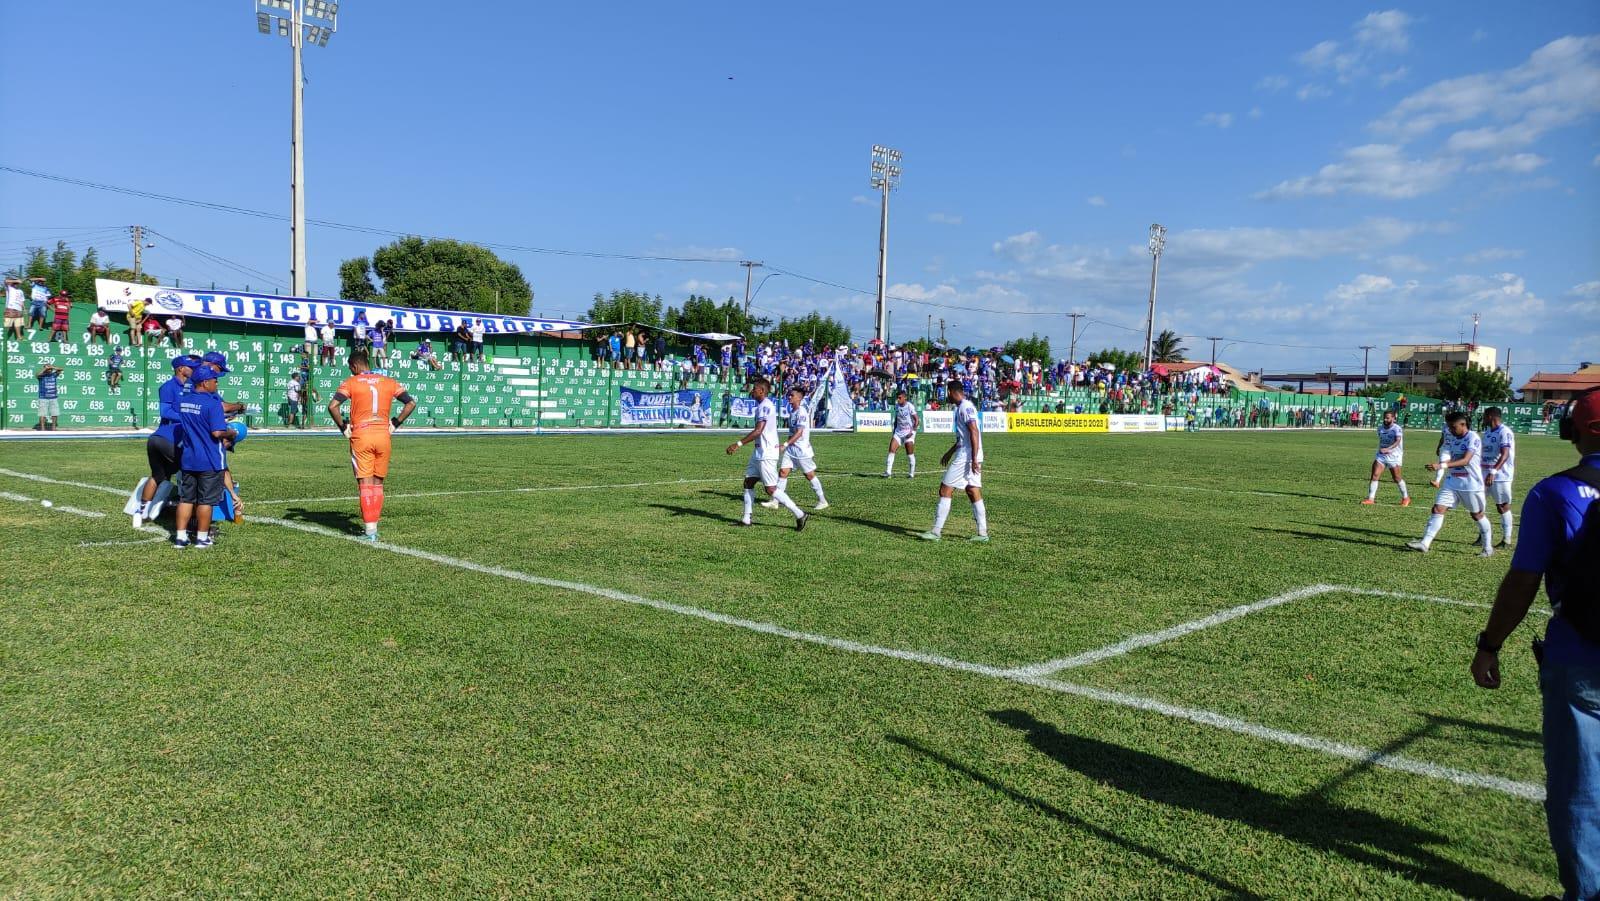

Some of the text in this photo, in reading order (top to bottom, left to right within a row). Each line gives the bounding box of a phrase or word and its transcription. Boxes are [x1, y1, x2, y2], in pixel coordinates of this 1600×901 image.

[195, 295, 369, 326] TORCIDA
[27, 329, 36, 340] 7
[83, 332, 91, 343] 9
[183, 338, 193, 348] 13
[206, 339, 217, 349] 14
[228, 340, 239, 350] 15
[252, 342, 262, 352] 16
[273, 342, 282, 352] 17
[334, 347, 345, 355] 20
[391, 350, 401, 359] 23
[31, 342, 50, 353] 133
[59, 343, 78, 354] 134
[86, 344, 104, 356] 135
[236, 352, 250, 362] 141
[280, 354, 295, 364] 143
[399, 360, 411, 369] 149
[484, 364, 495, 372] 154
[7, 355, 25, 364] 258
[38, 356, 55, 365] 259
[66, 357, 83, 366] 260
[94, 359, 108, 367] 261
[147, 361, 161, 369] 263
[243, 365, 257, 373] 267
[389, 370, 401, 378] 274
[426, 372, 436, 380] 276
[15, 369, 33, 379] 384
[73, 371, 91, 380] 386
[128, 372, 144, 382] 388
[228, 376, 243, 386] 392
[251, 377, 265, 386] 393
[274, 378, 287, 387] 394
[319, 380, 331, 388] 396
[416, 383, 426, 391] 401
[24, 385, 38, 393] 510
[82, 386, 96, 395] 512
[237, 390, 249, 399] 518
[370, 386, 378, 415] 1
[640, 393, 680, 405] PODER
[63, 400, 78, 409] 637
[90, 401, 104, 410] 638
[117, 401, 130, 410] 639
[268, 404, 280, 412] 645
[1374, 402, 1388, 410] EU
[1409, 402, 1436, 412] PHB
[1515, 406, 1532, 415] FAZ
[9, 414, 24, 423] 761
[71, 415, 86, 423] 763
[98, 415, 113, 423] 764
[1016, 417, 1062, 427] BRASILEIRÃO
[1064, 417, 1083, 427] SÉRIE
